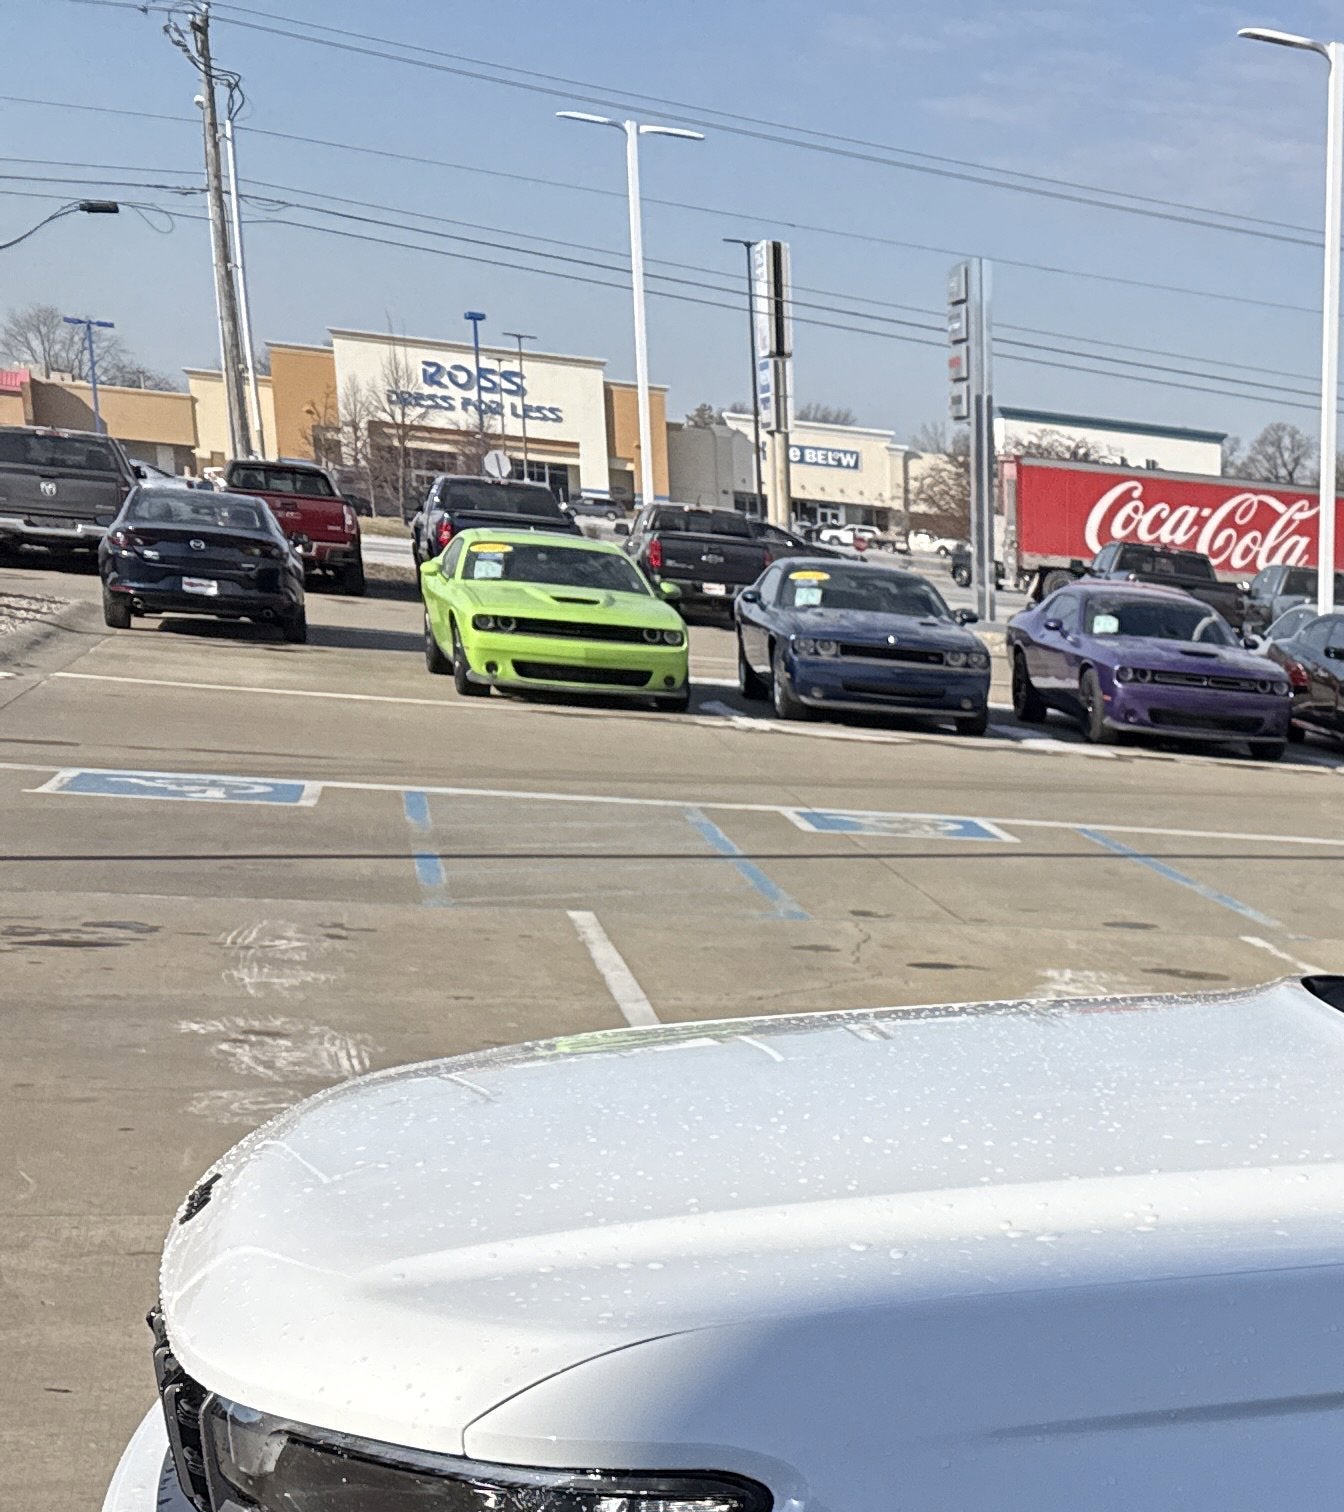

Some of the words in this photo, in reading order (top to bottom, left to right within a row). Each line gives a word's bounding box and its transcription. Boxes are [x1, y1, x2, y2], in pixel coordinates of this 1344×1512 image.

[422, 360, 527, 397] ROSS
[387, 389, 456, 411] DRESS
[461, 396, 504, 416] FOR
[511, 402, 563, 422] LESS
[804, 448, 857, 467] BELOW
[1085, 481, 1320, 570] Coca-Cola
